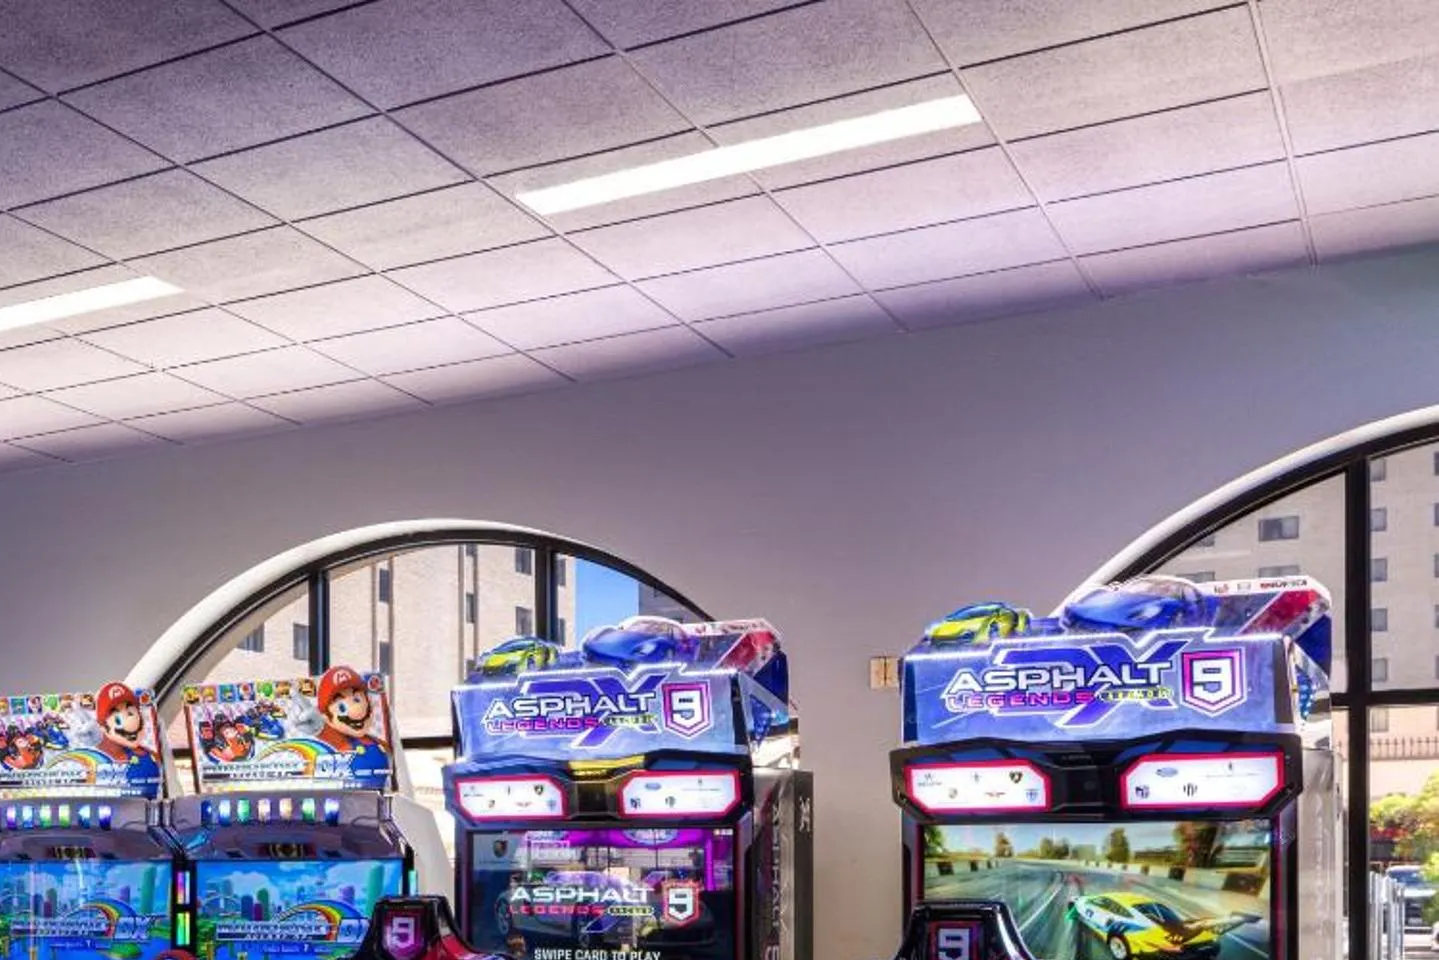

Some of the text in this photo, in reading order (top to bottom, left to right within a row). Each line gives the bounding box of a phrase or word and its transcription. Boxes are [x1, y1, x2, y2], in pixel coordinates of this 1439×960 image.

[949, 659, 1233, 706] ASPHALT 9
[946, 690, 1095, 708] LEGENDS
[487, 691, 656, 718] ASPHALT
[672, 691, 704, 725] 9
[485, 716, 599, 732] LEGENDS
[510, 887, 655, 903] ASPHALT
[508, 905, 605, 916] LEGENDS
[534, 948, 572, 960] SWIPE
